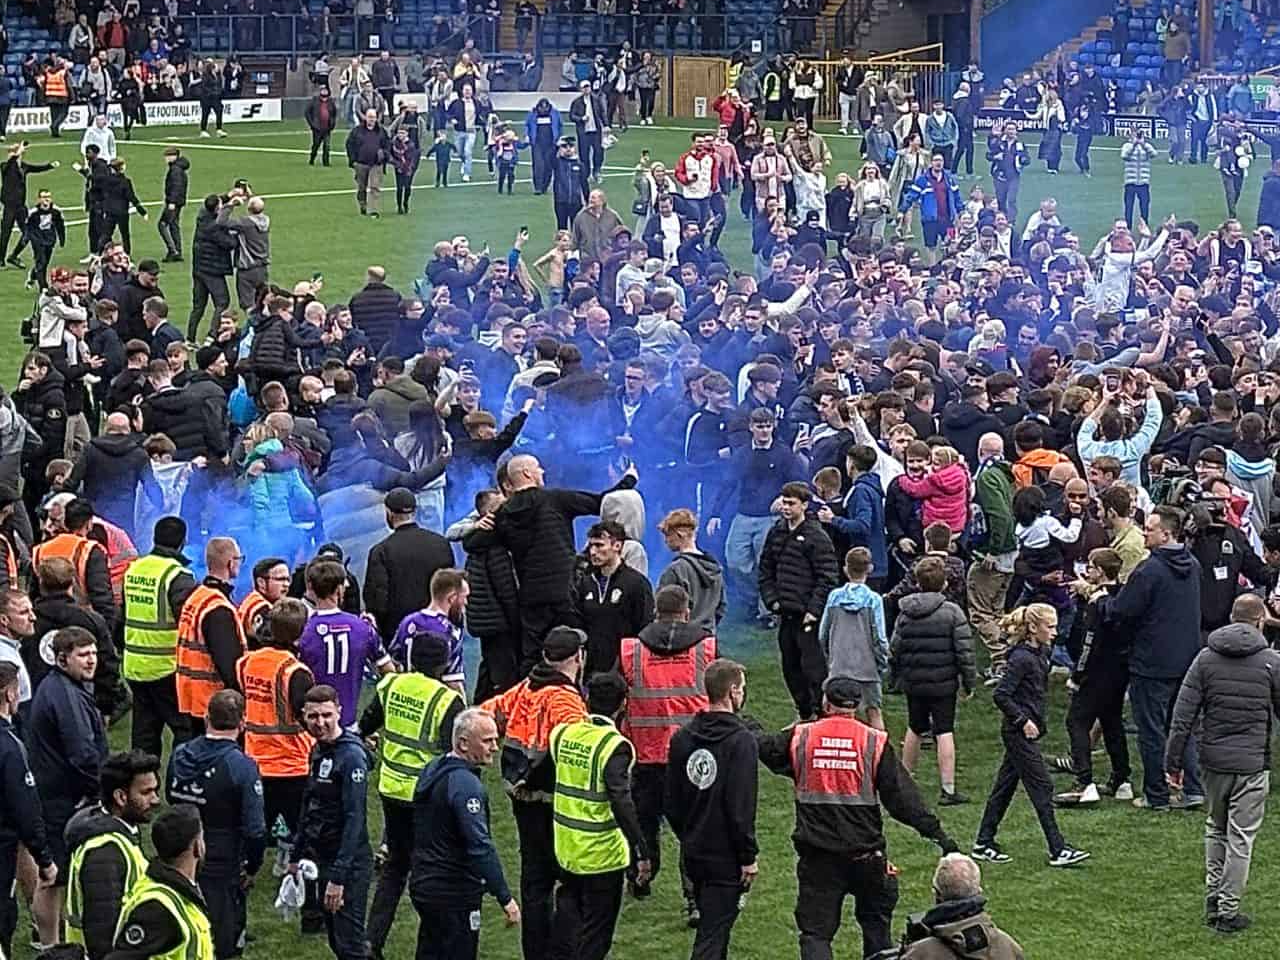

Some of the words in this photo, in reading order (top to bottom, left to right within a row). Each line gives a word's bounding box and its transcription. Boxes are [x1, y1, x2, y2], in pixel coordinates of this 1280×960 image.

[157, 103, 190, 118] FOOTBALL
[323, 632, 349, 675] 11
[390, 691, 425, 710] TAURUS
